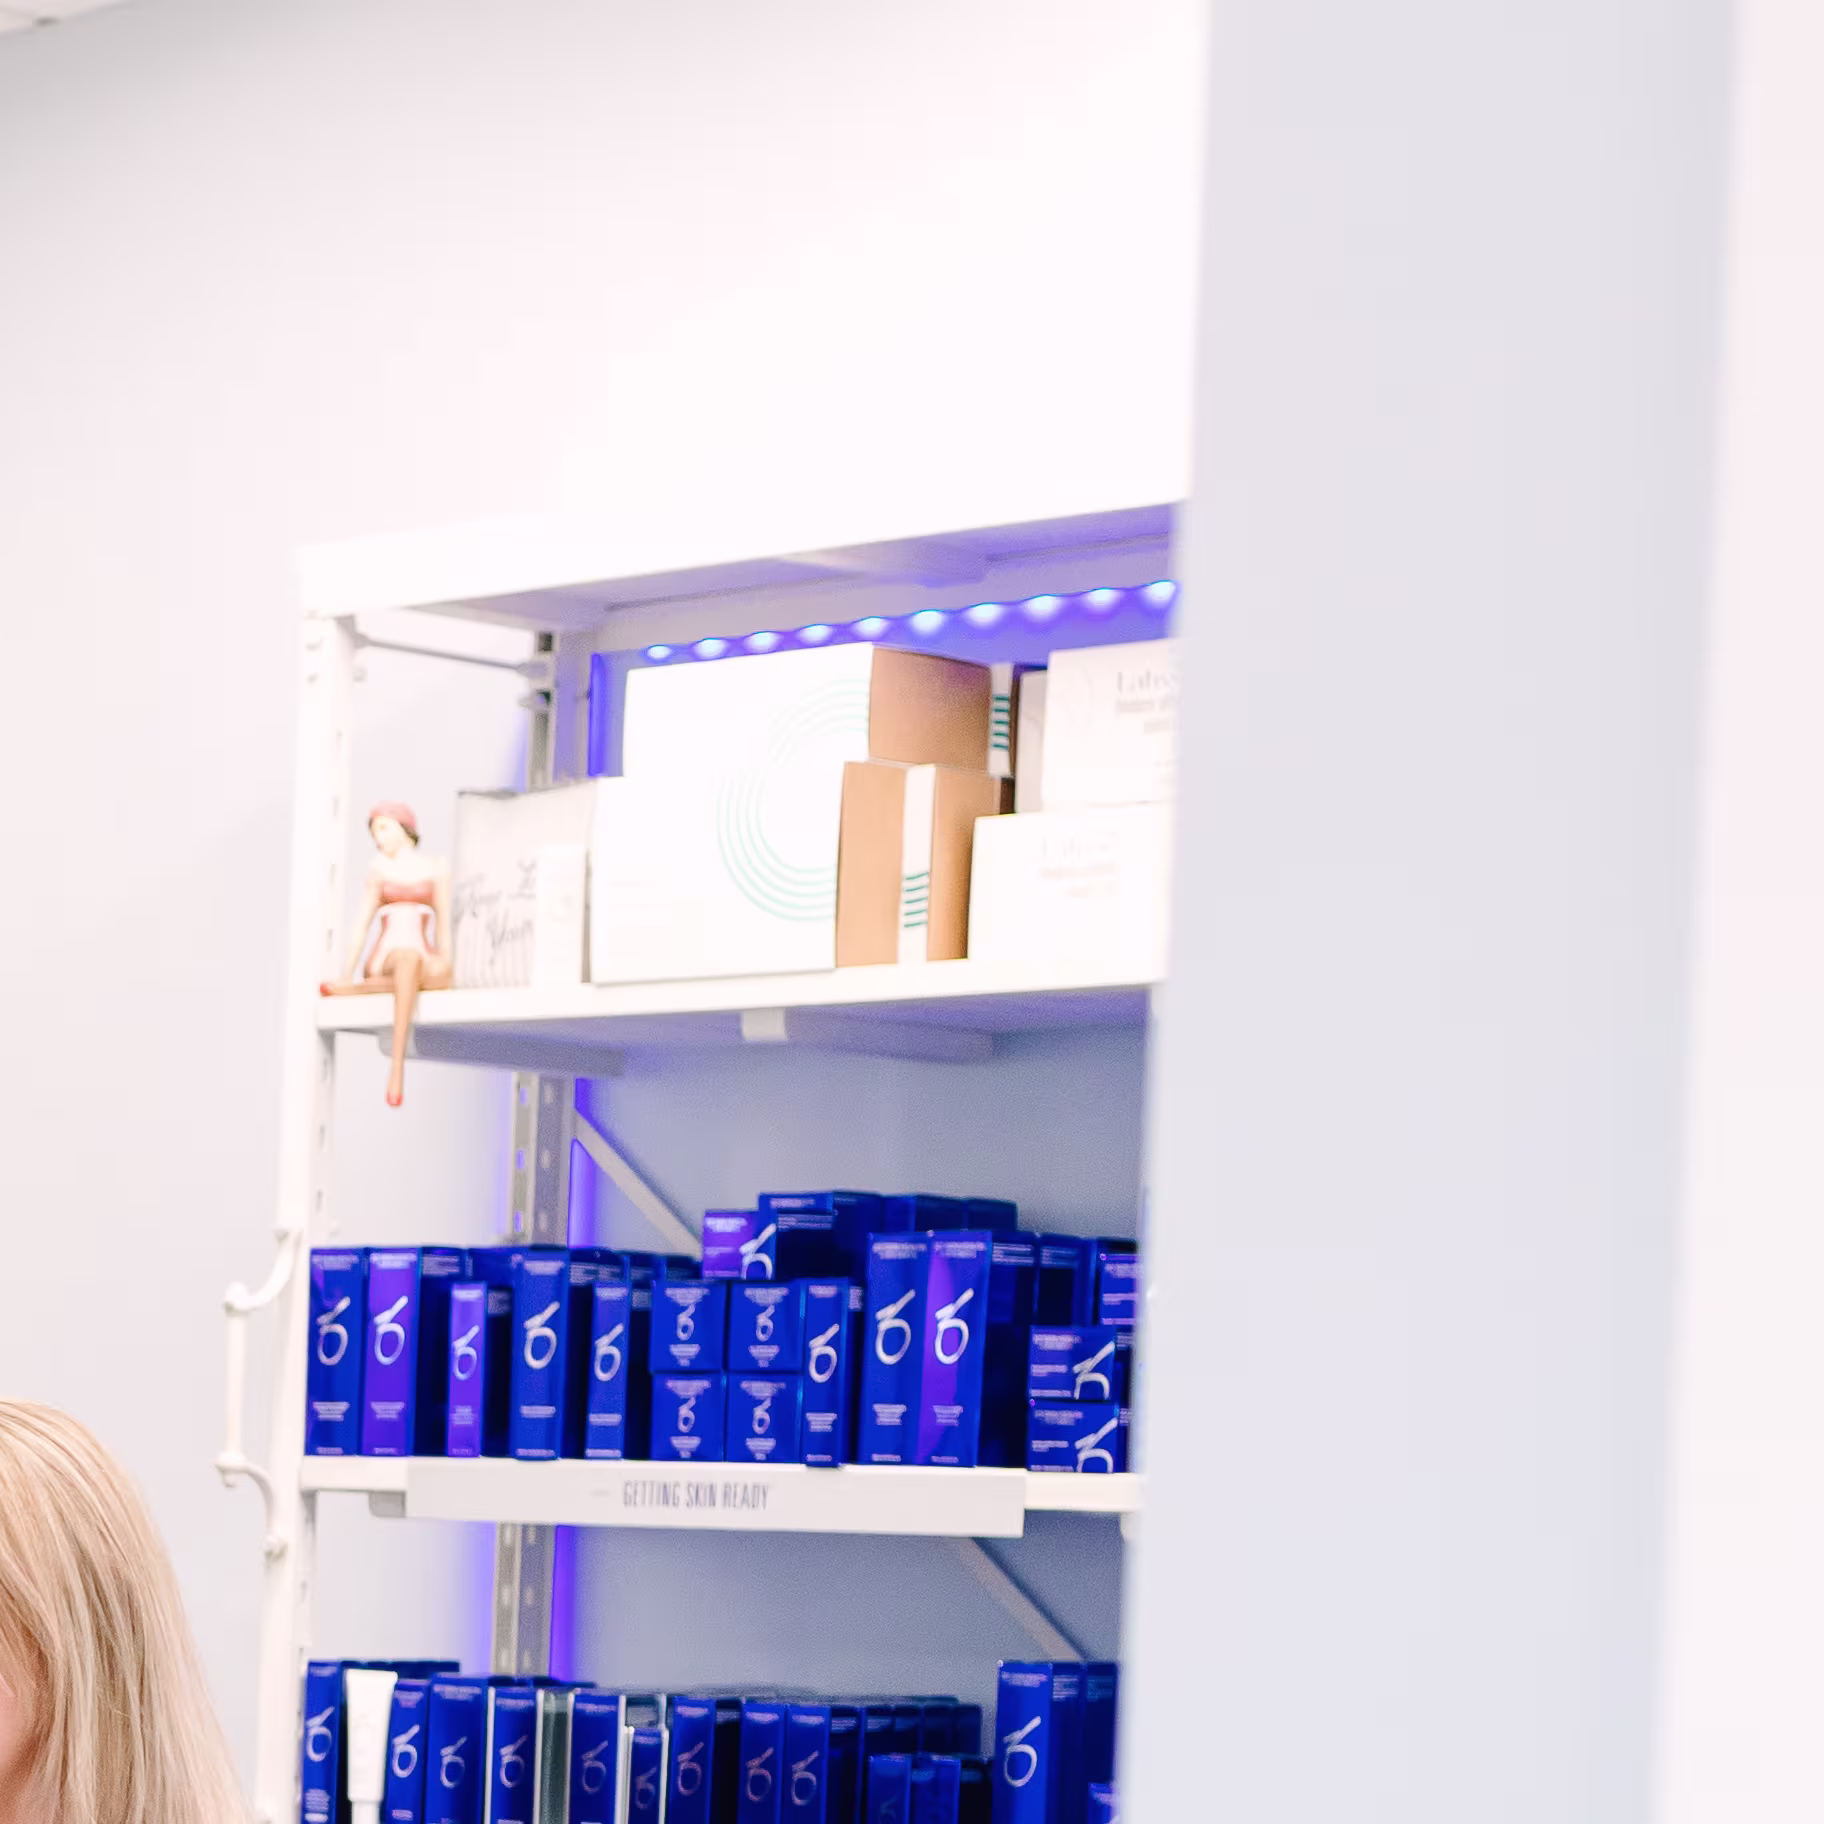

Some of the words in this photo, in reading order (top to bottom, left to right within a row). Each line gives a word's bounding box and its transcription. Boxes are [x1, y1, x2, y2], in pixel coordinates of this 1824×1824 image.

[623, 1479, 680, 1508] GETTING
[686, 1481, 717, 1509] SKIN
[723, 1481, 770, 1511] READY
